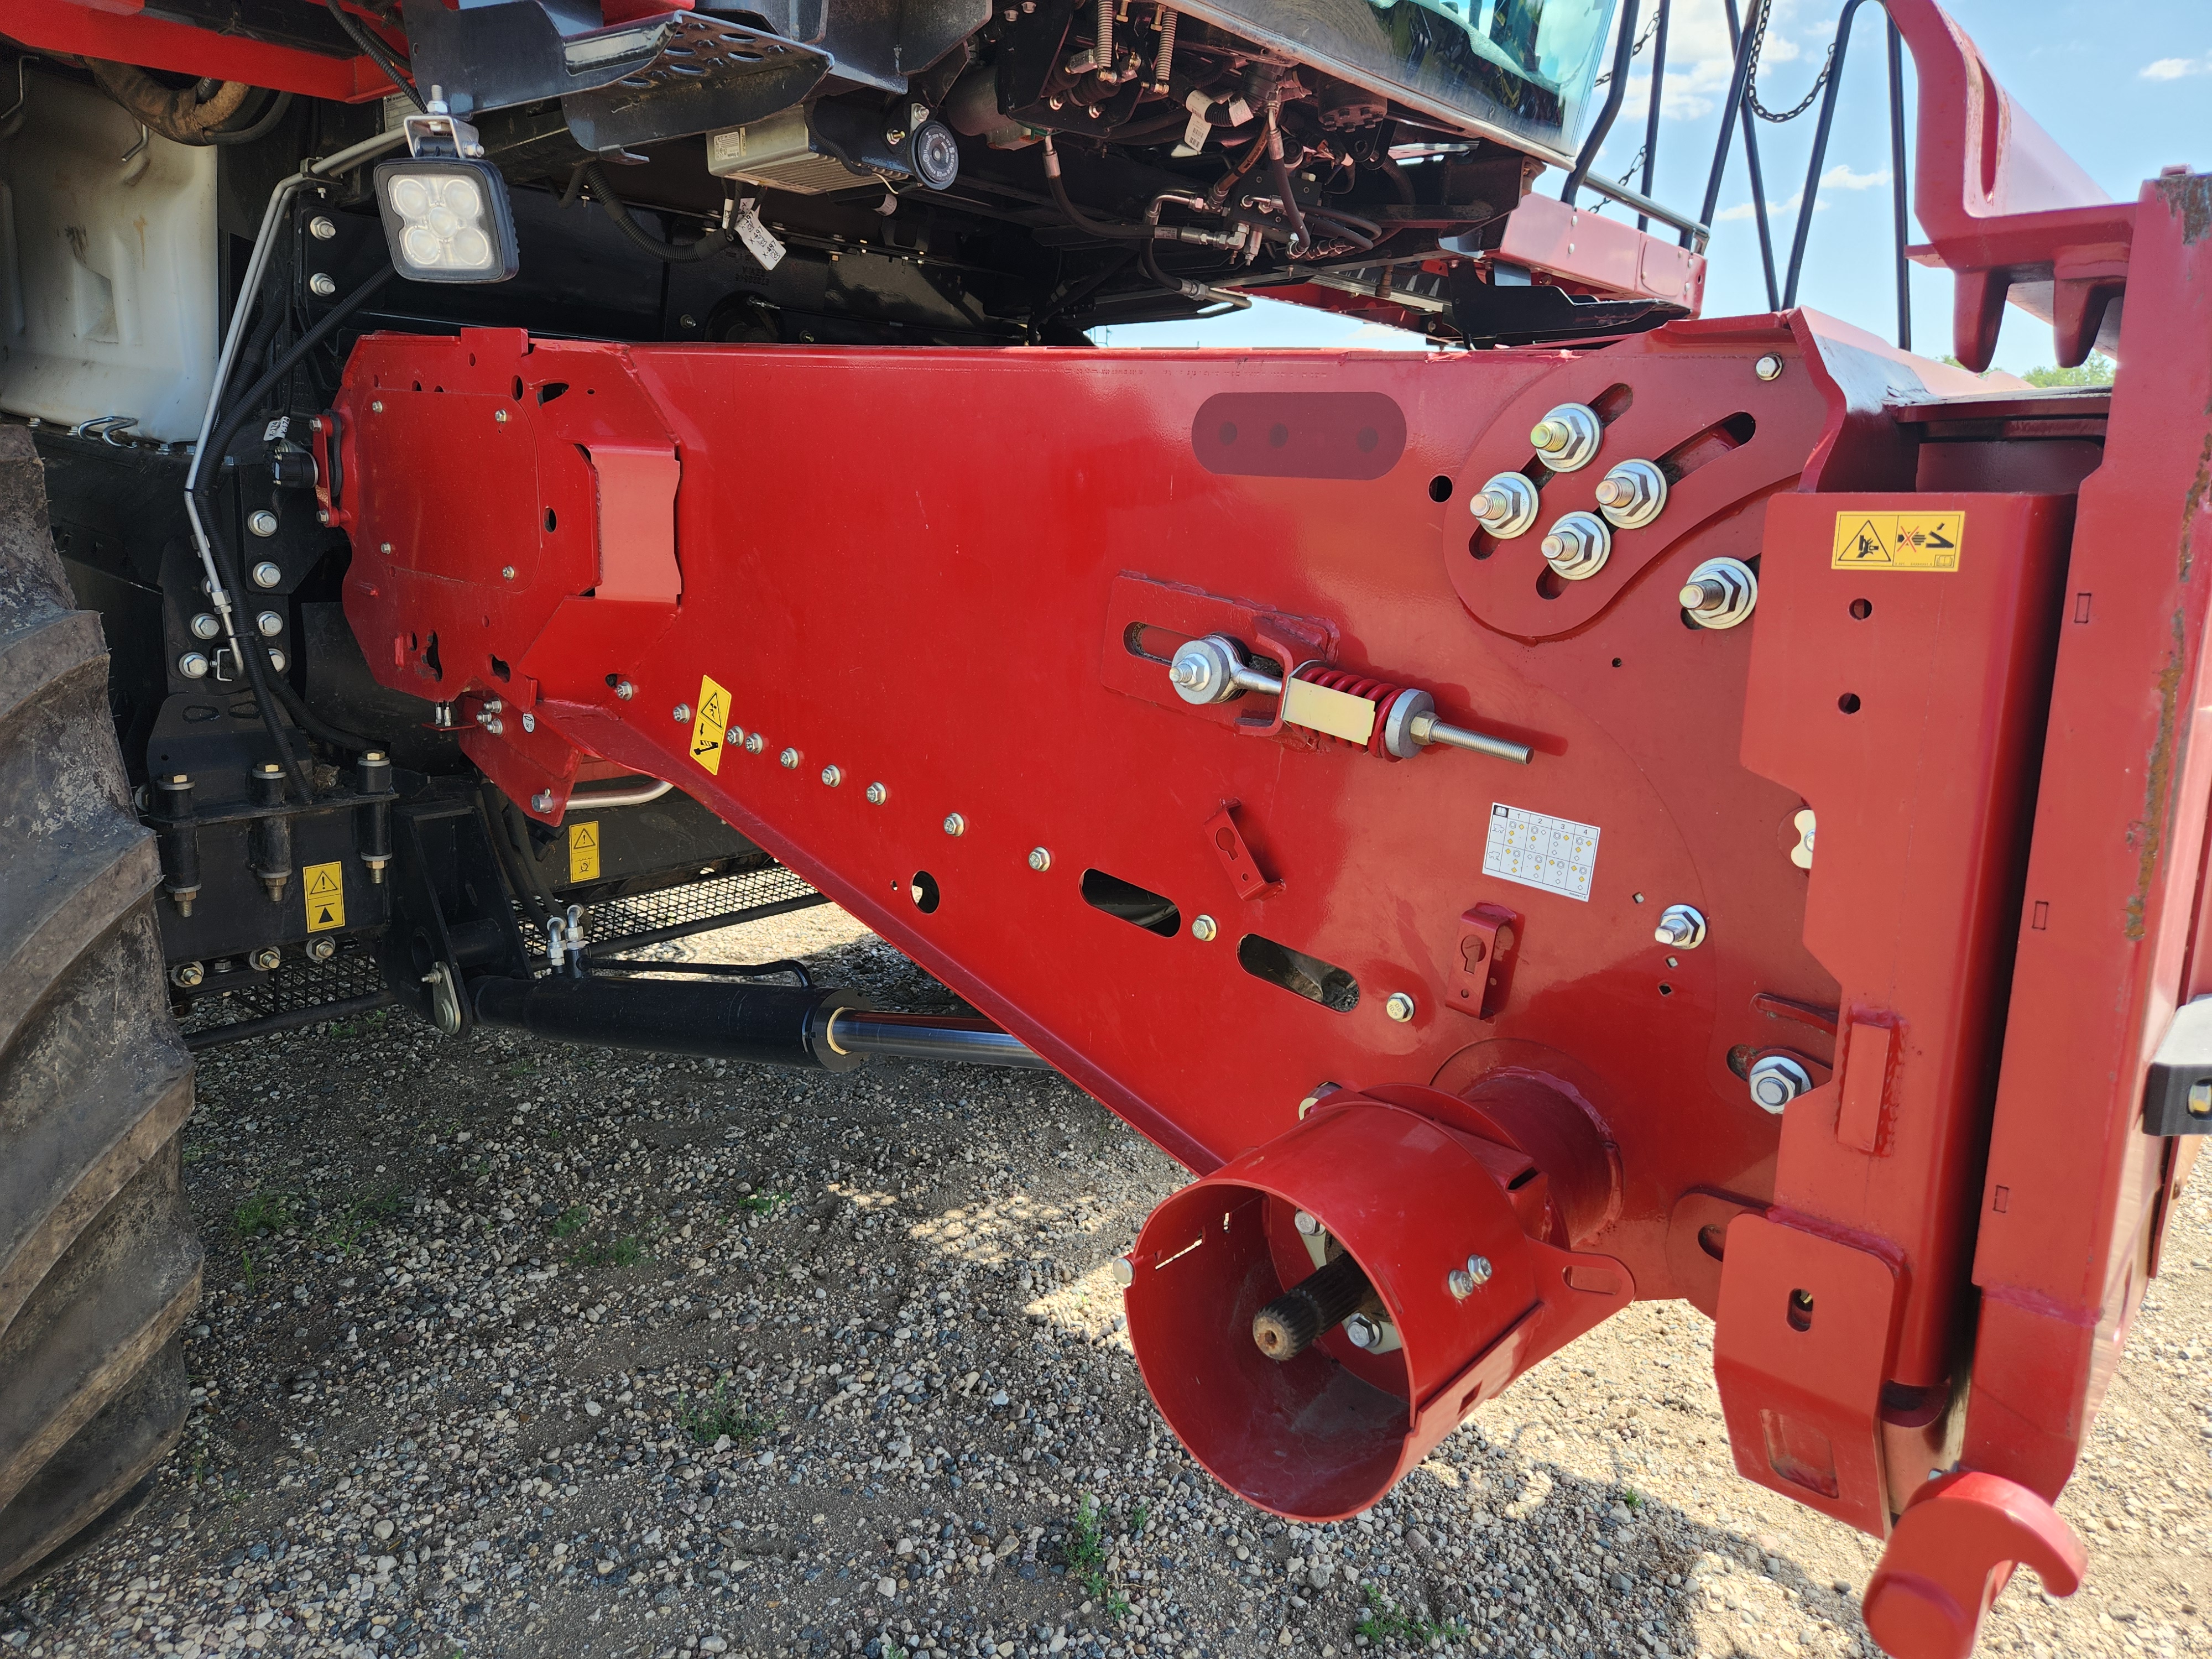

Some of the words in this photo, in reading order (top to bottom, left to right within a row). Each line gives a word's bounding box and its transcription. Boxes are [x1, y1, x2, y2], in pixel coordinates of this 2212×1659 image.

[748, 226, 764, 245] X-497
[761, 239, 777, 259] X-497
[268, 421, 279, 437] X-174
[280, 418, 290, 435] X-174
[1394, 1003, 1402, 1012] DB
